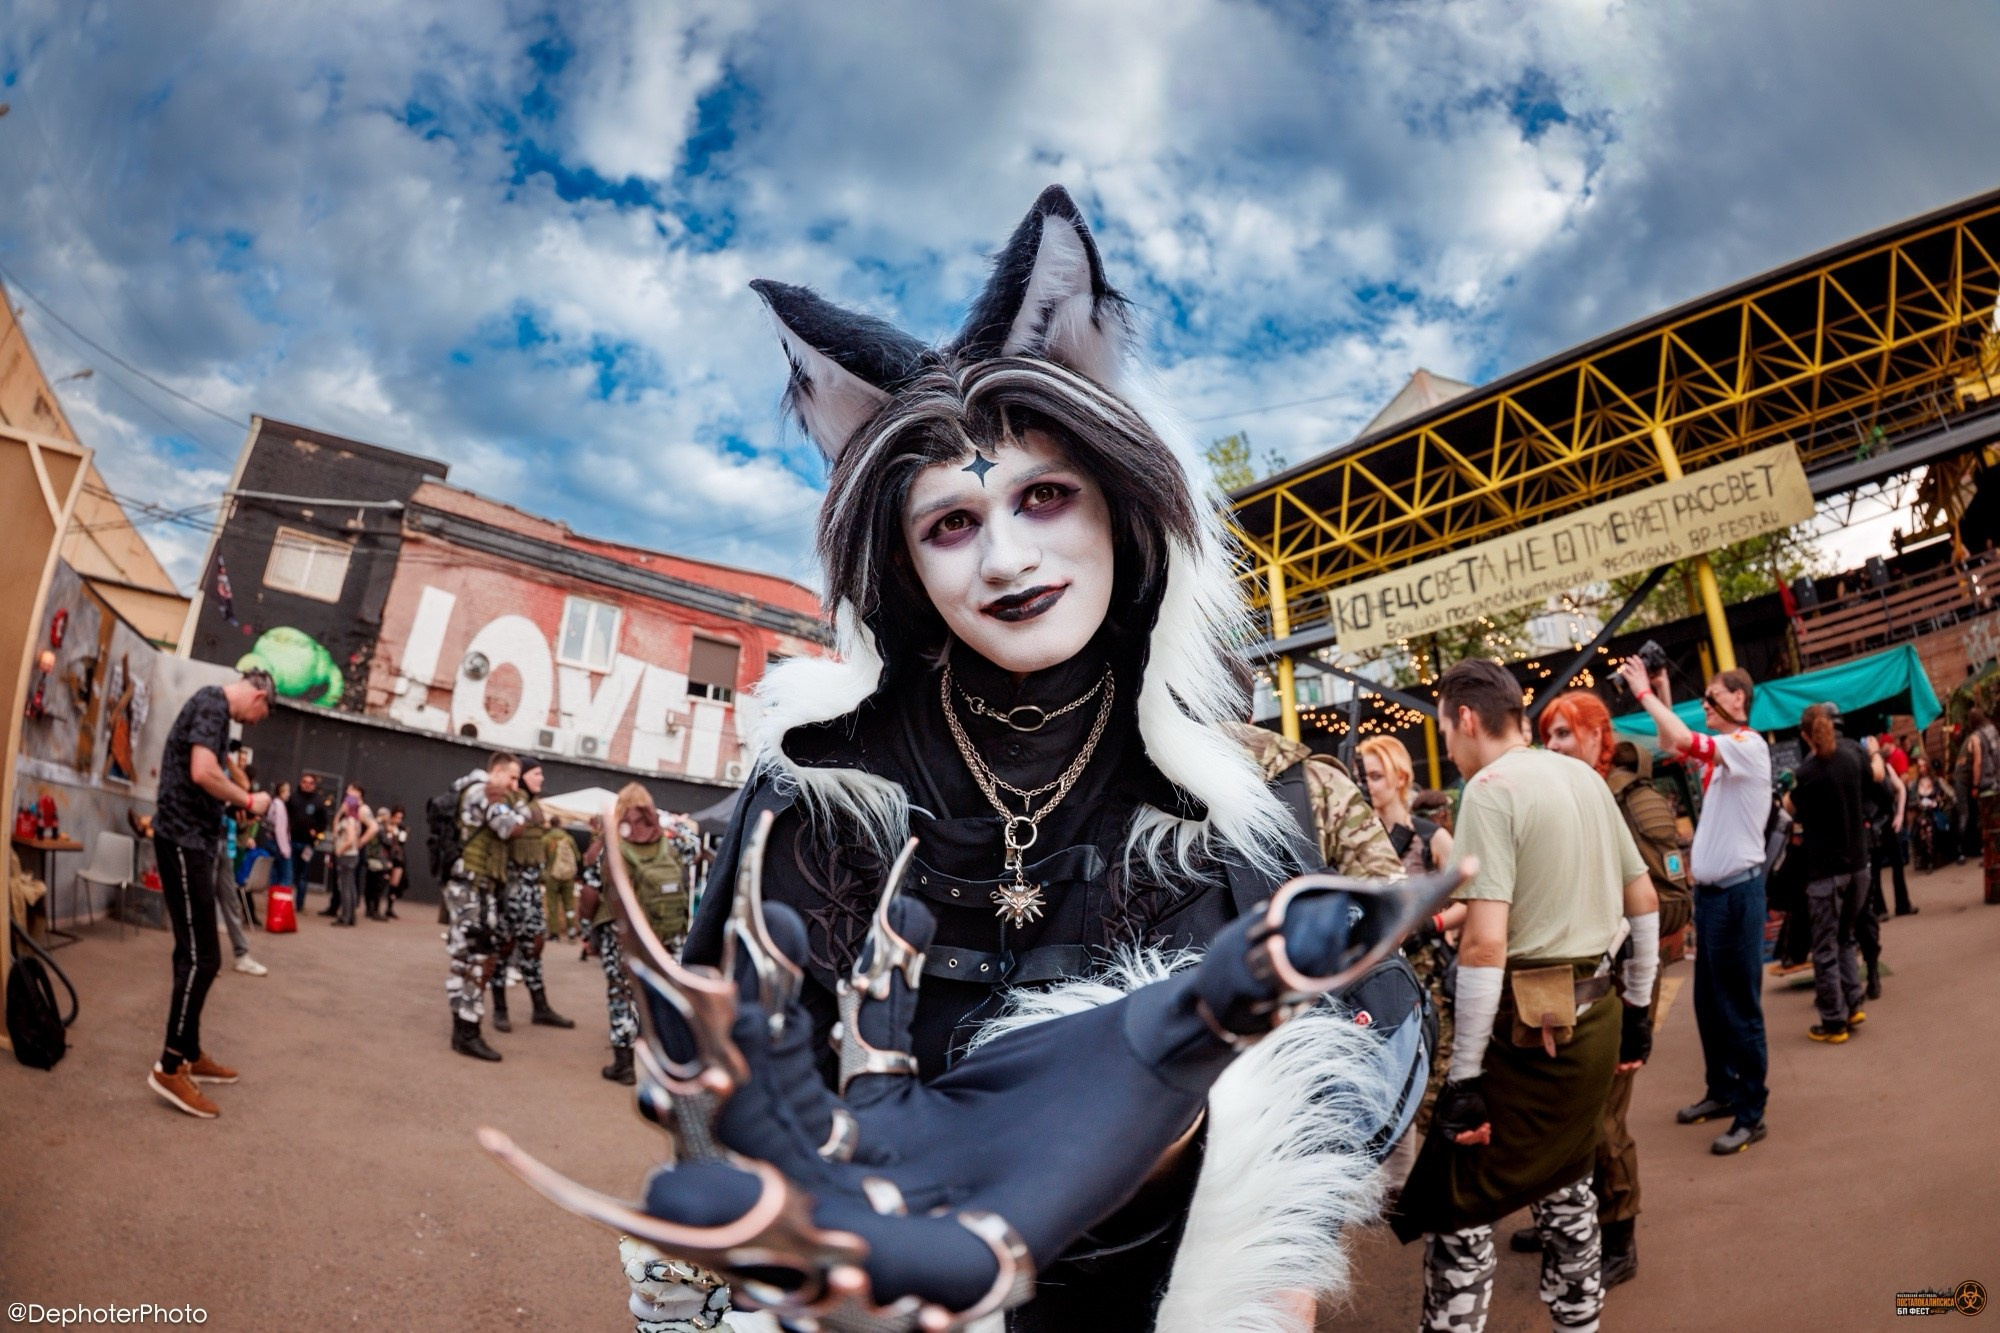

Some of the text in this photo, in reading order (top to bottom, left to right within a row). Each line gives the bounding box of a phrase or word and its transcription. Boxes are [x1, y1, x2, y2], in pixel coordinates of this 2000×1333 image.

[1337, 581, 1418, 634] КОНЕЦ
[1503, 536, 1548, 580] НЕ
[1552, 497, 1670, 564] ОТМЕНЯЕТ
[1673, 464, 1774, 525] РАССВЕТ
[1600, 537, 1682, 576] ФЕСТИВАЛЬ
[1688, 510, 1780, 551] BP-FEST.RU
